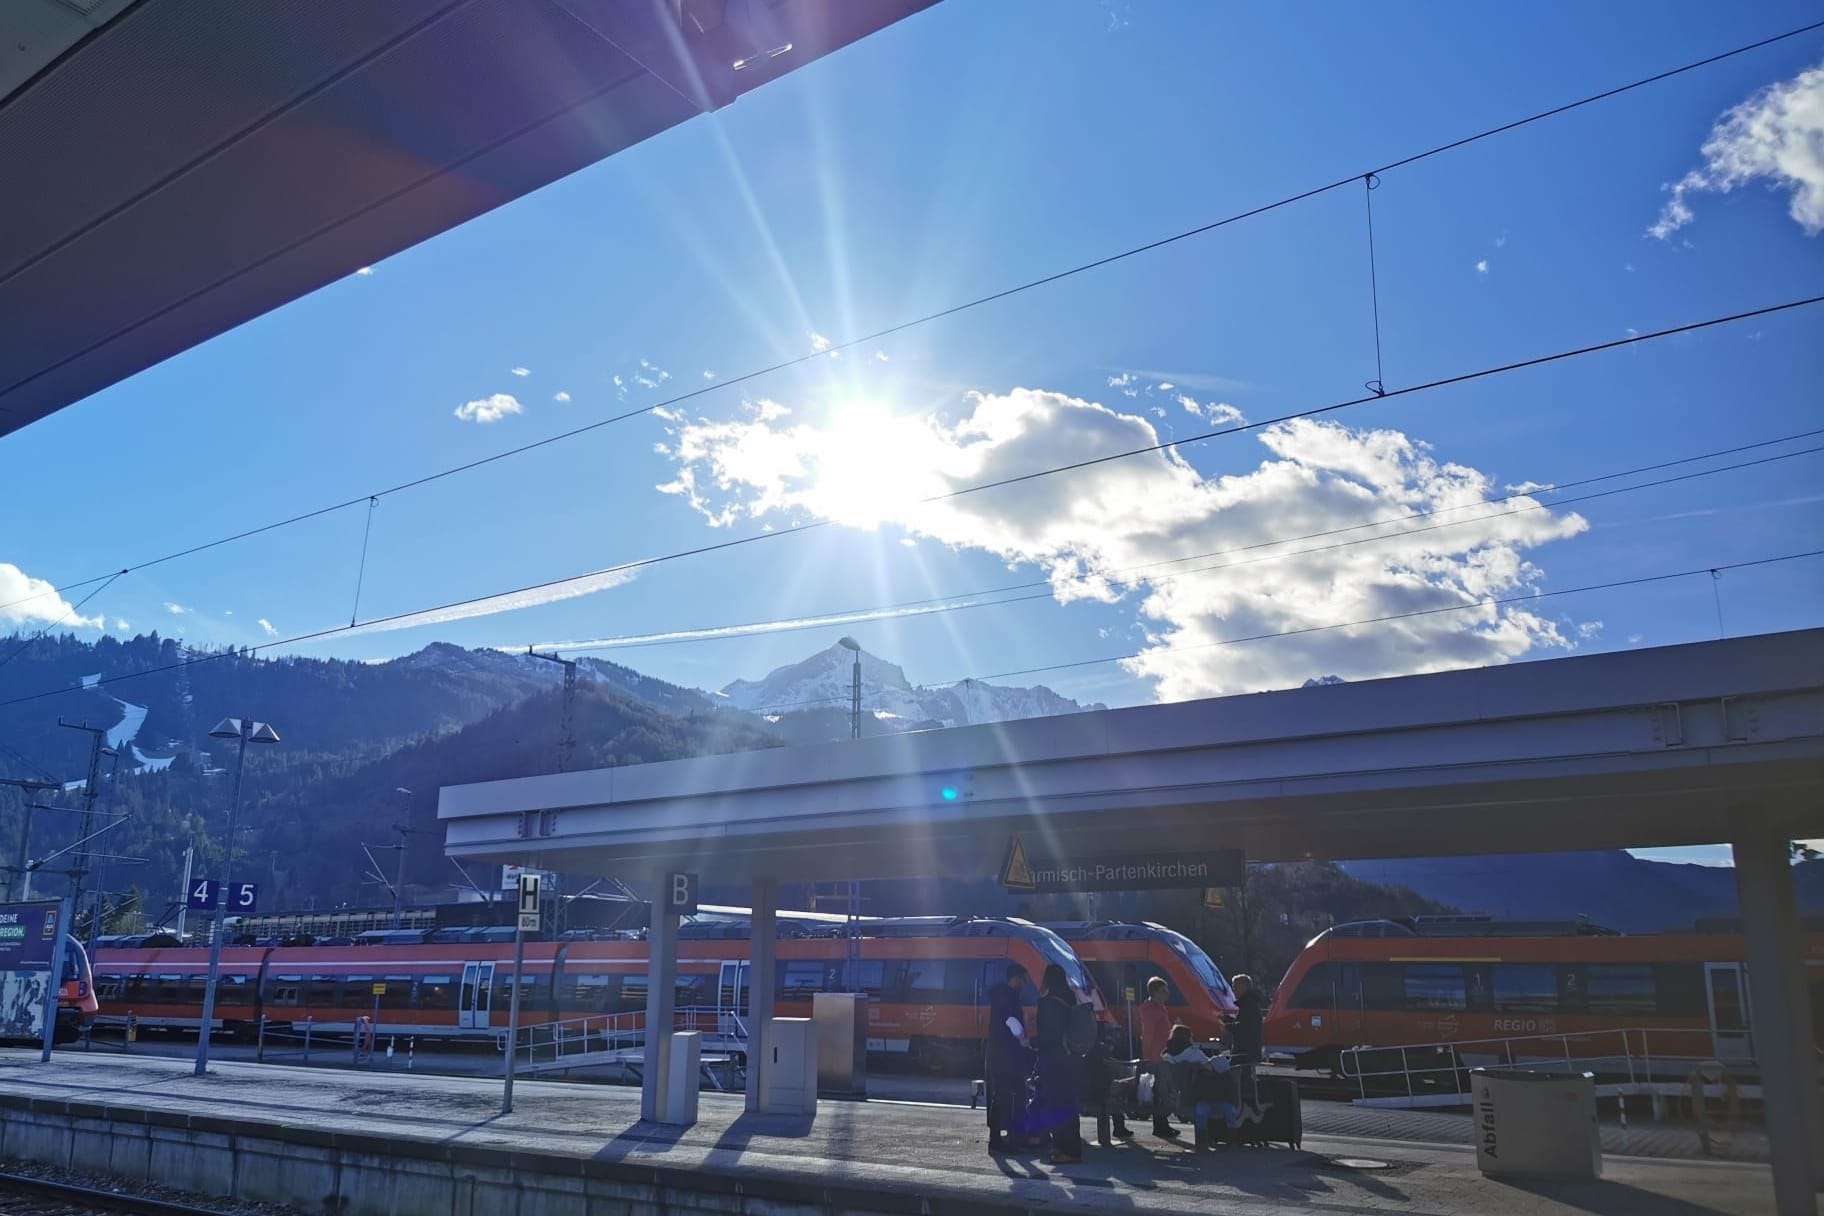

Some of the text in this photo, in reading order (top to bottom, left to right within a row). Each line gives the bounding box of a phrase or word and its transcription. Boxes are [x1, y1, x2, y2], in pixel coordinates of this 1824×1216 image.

[193, 880, 209, 903] 4
[239, 884, 255, 906] 5
[521, 877, 539, 910] H
[673, 874, 689, 905] B
[828, 968, 836, 979] 2
[1567, 973, 1576, 987] 2
[1494, 1019, 1537, 1032] REGIO
[1480, 1102, 1498, 1159] Abfall
